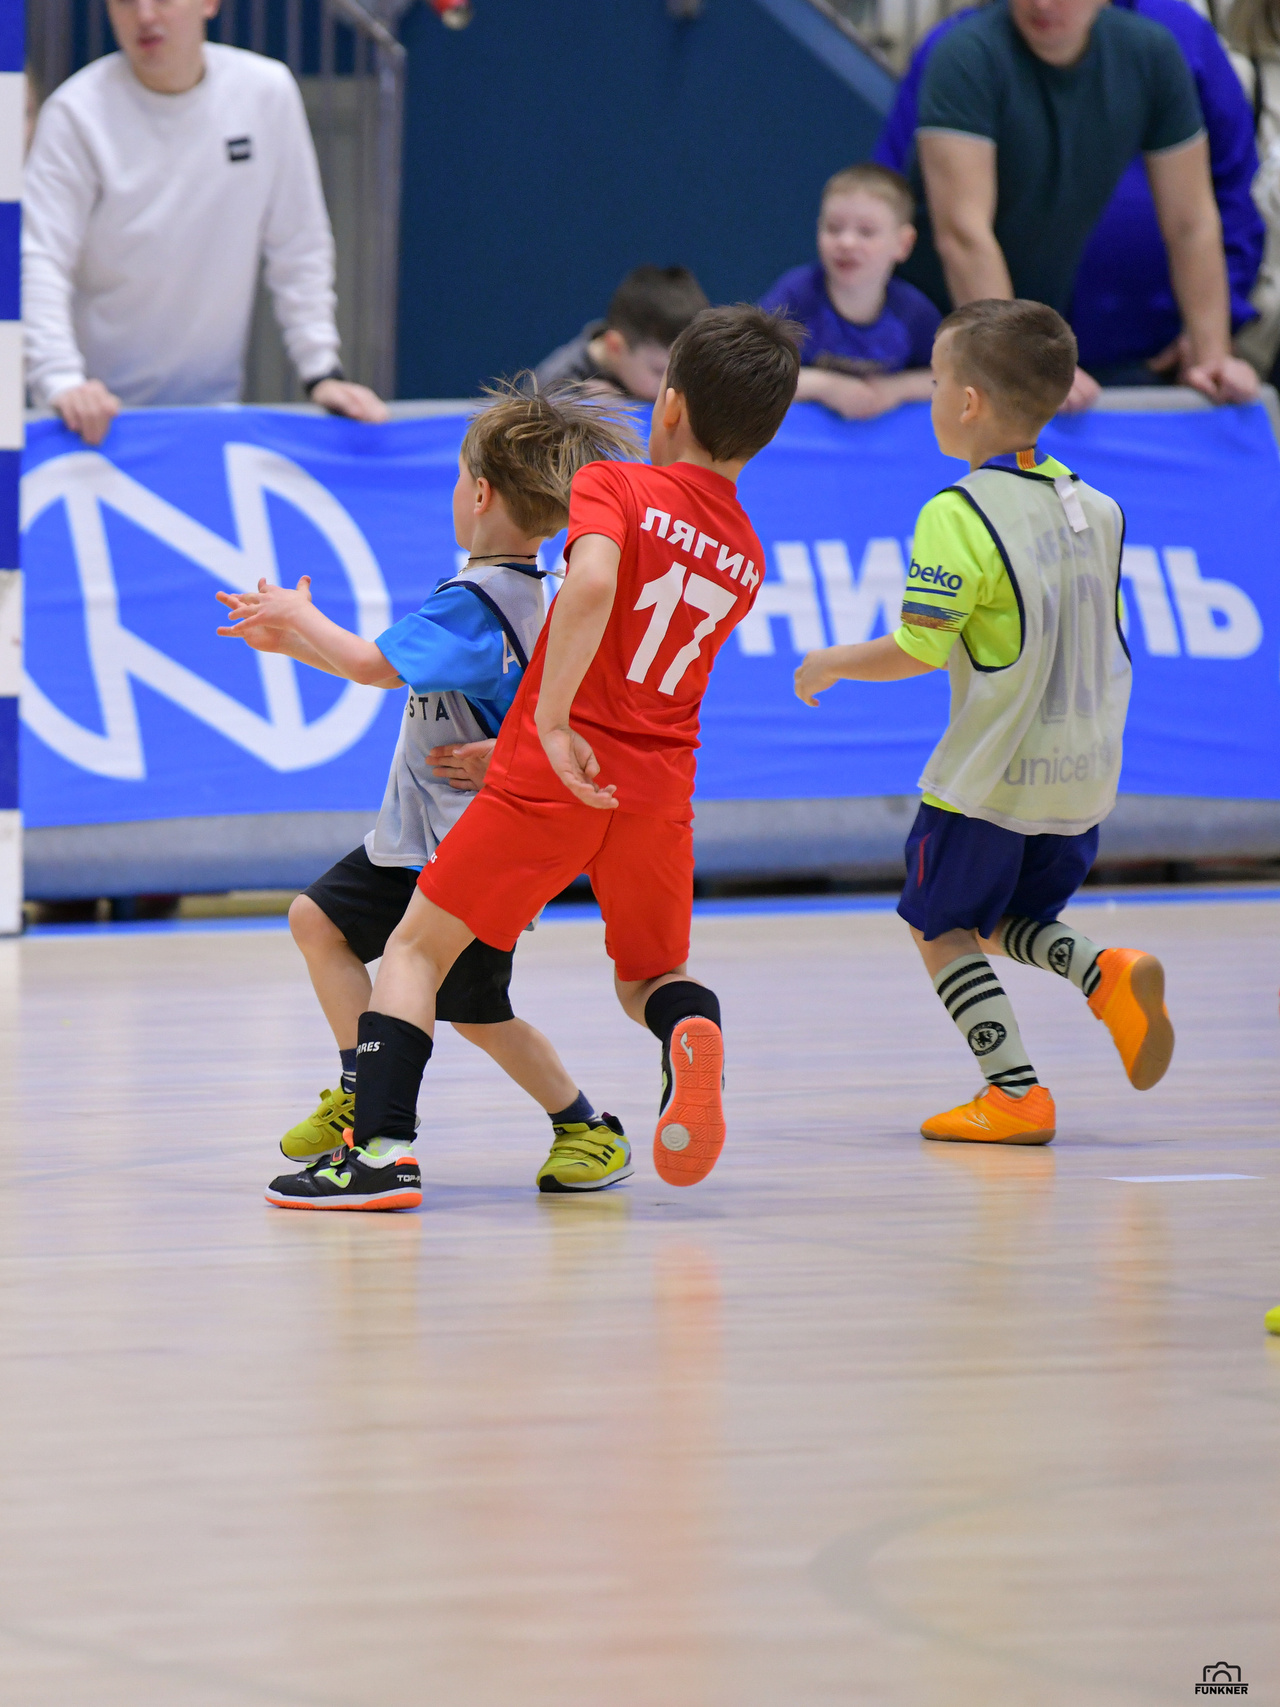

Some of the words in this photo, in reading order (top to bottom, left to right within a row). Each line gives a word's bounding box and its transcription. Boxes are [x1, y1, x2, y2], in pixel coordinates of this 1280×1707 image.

[640, 506, 761, 594] ЛЯГИН
[908, 558, 963, 590] beko
[626, 561, 738, 696] 17
[405, 695, 451, 722] STA
